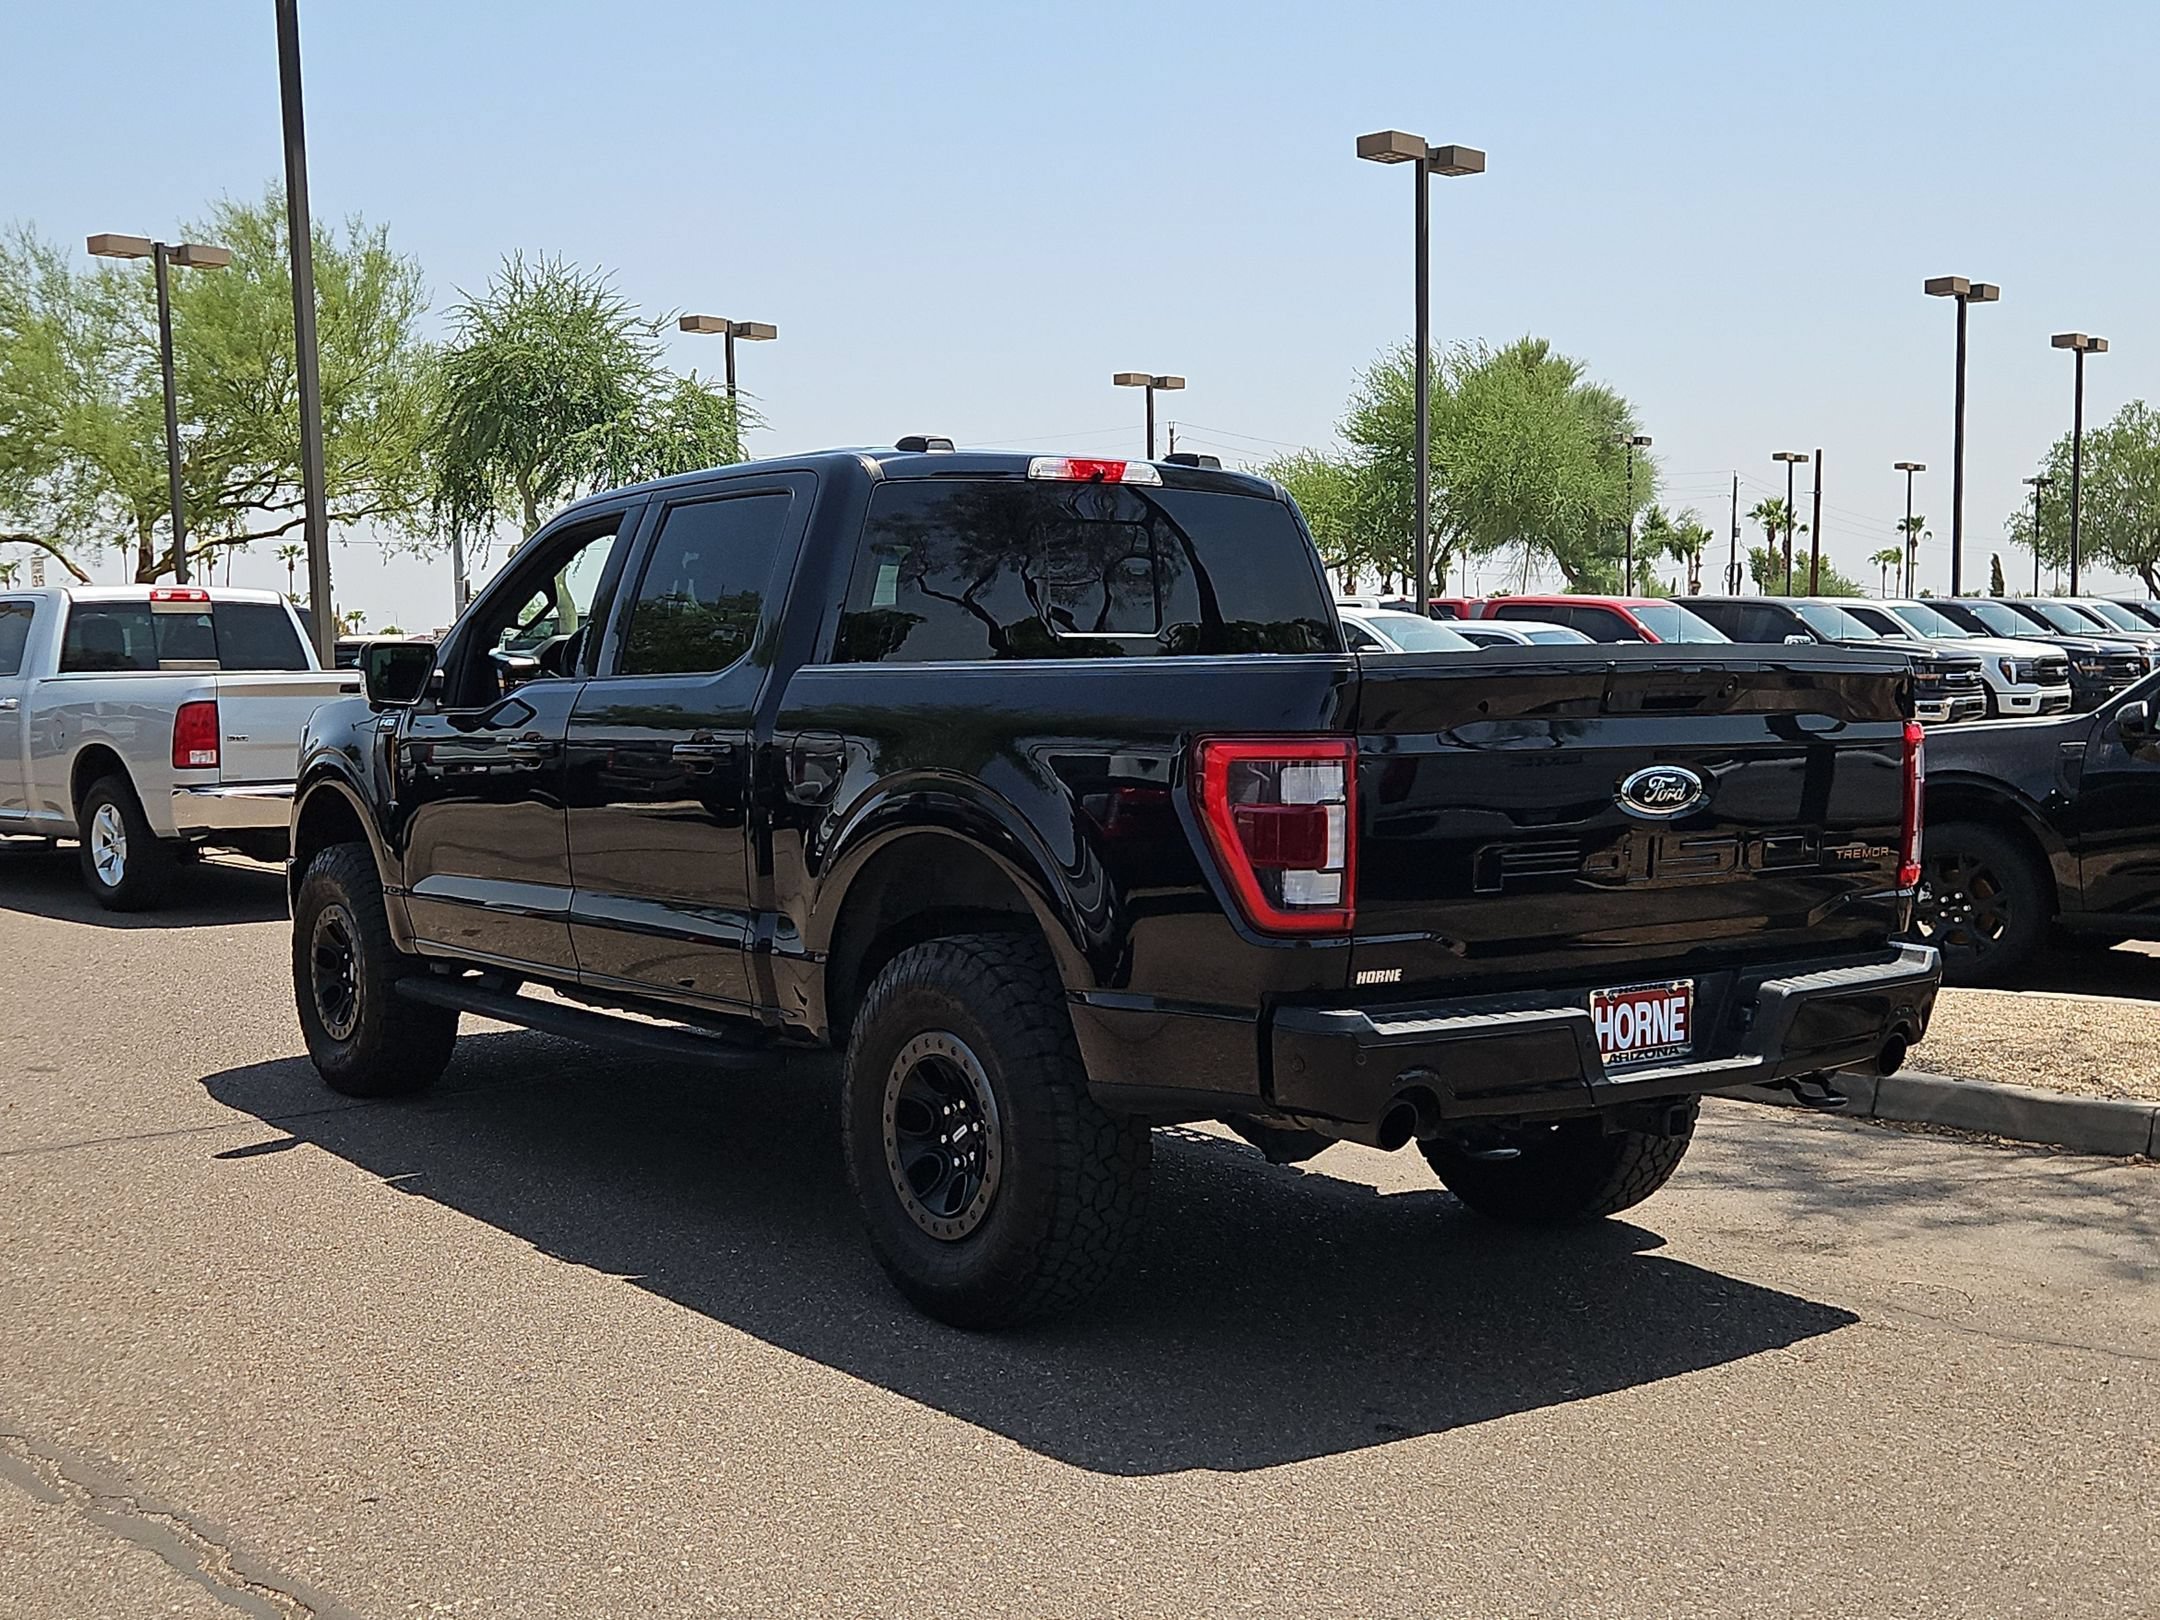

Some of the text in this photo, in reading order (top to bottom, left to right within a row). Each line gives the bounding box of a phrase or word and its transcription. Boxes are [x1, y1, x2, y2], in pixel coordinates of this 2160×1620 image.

[1643, 775, 1687, 803] Ford
[1836, 846, 1889, 860] TREMOR
[1356, 968, 1402, 985] HORNE
[1595, 997, 1685, 1051] HORNE
[1607, 1045, 1680, 1064] ARIZONA
